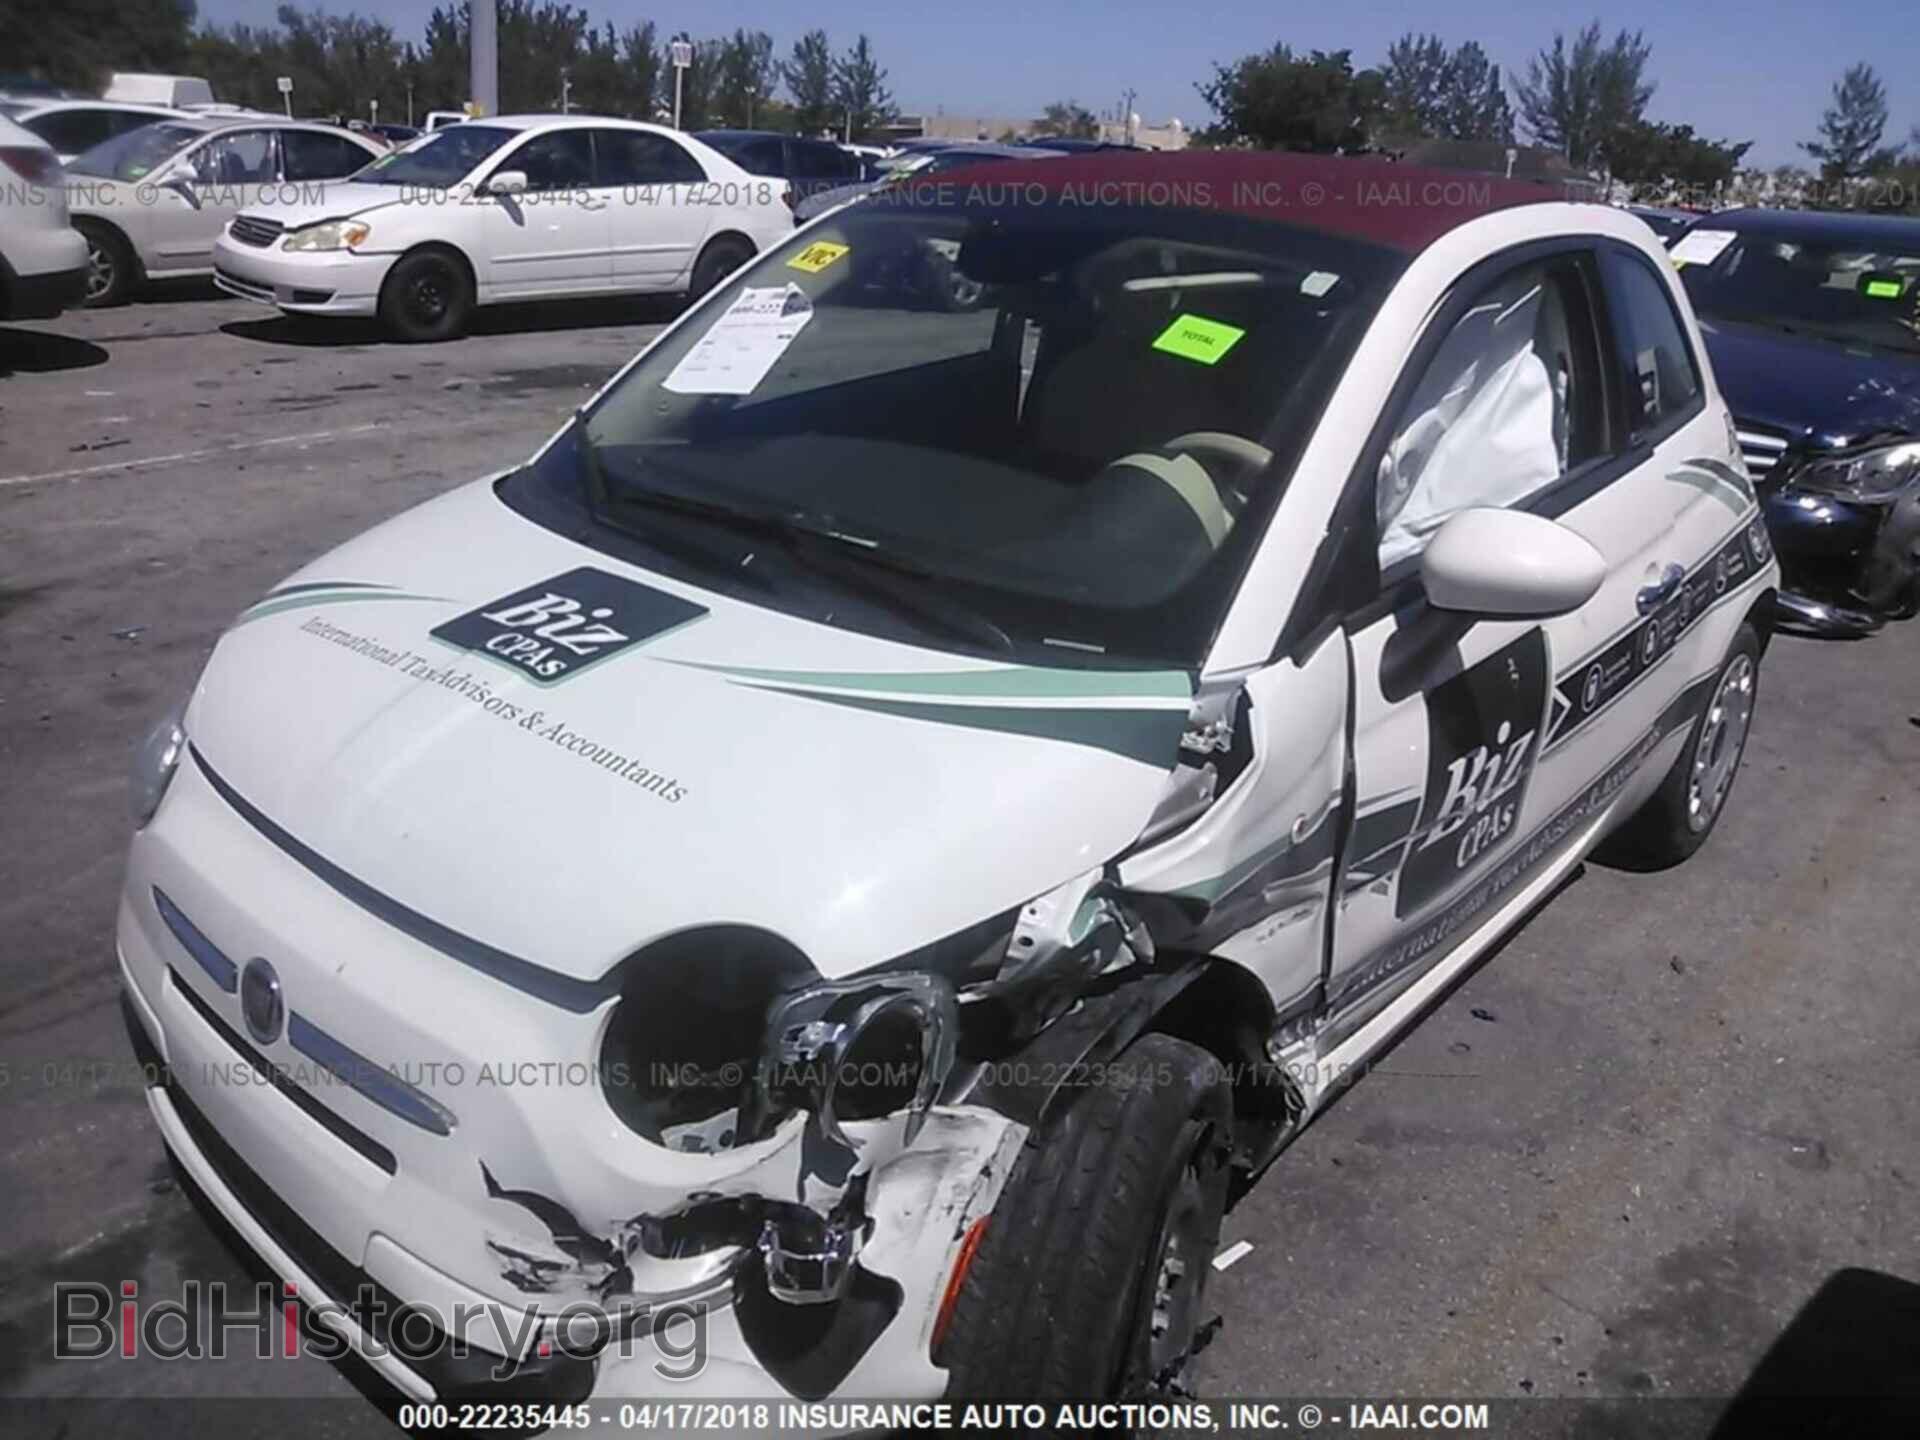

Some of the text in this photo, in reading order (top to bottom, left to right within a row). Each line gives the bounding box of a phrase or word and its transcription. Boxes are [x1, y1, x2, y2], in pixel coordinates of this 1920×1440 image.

[1181, 329, 1217, 346] TOTAL
[480, 592, 630, 656] Biz
[300, 614, 411, 668] International
[518, 710, 545, 731] &
[539, 721, 689, 805] Accountants
[1418, 720, 1535, 852] Biz
